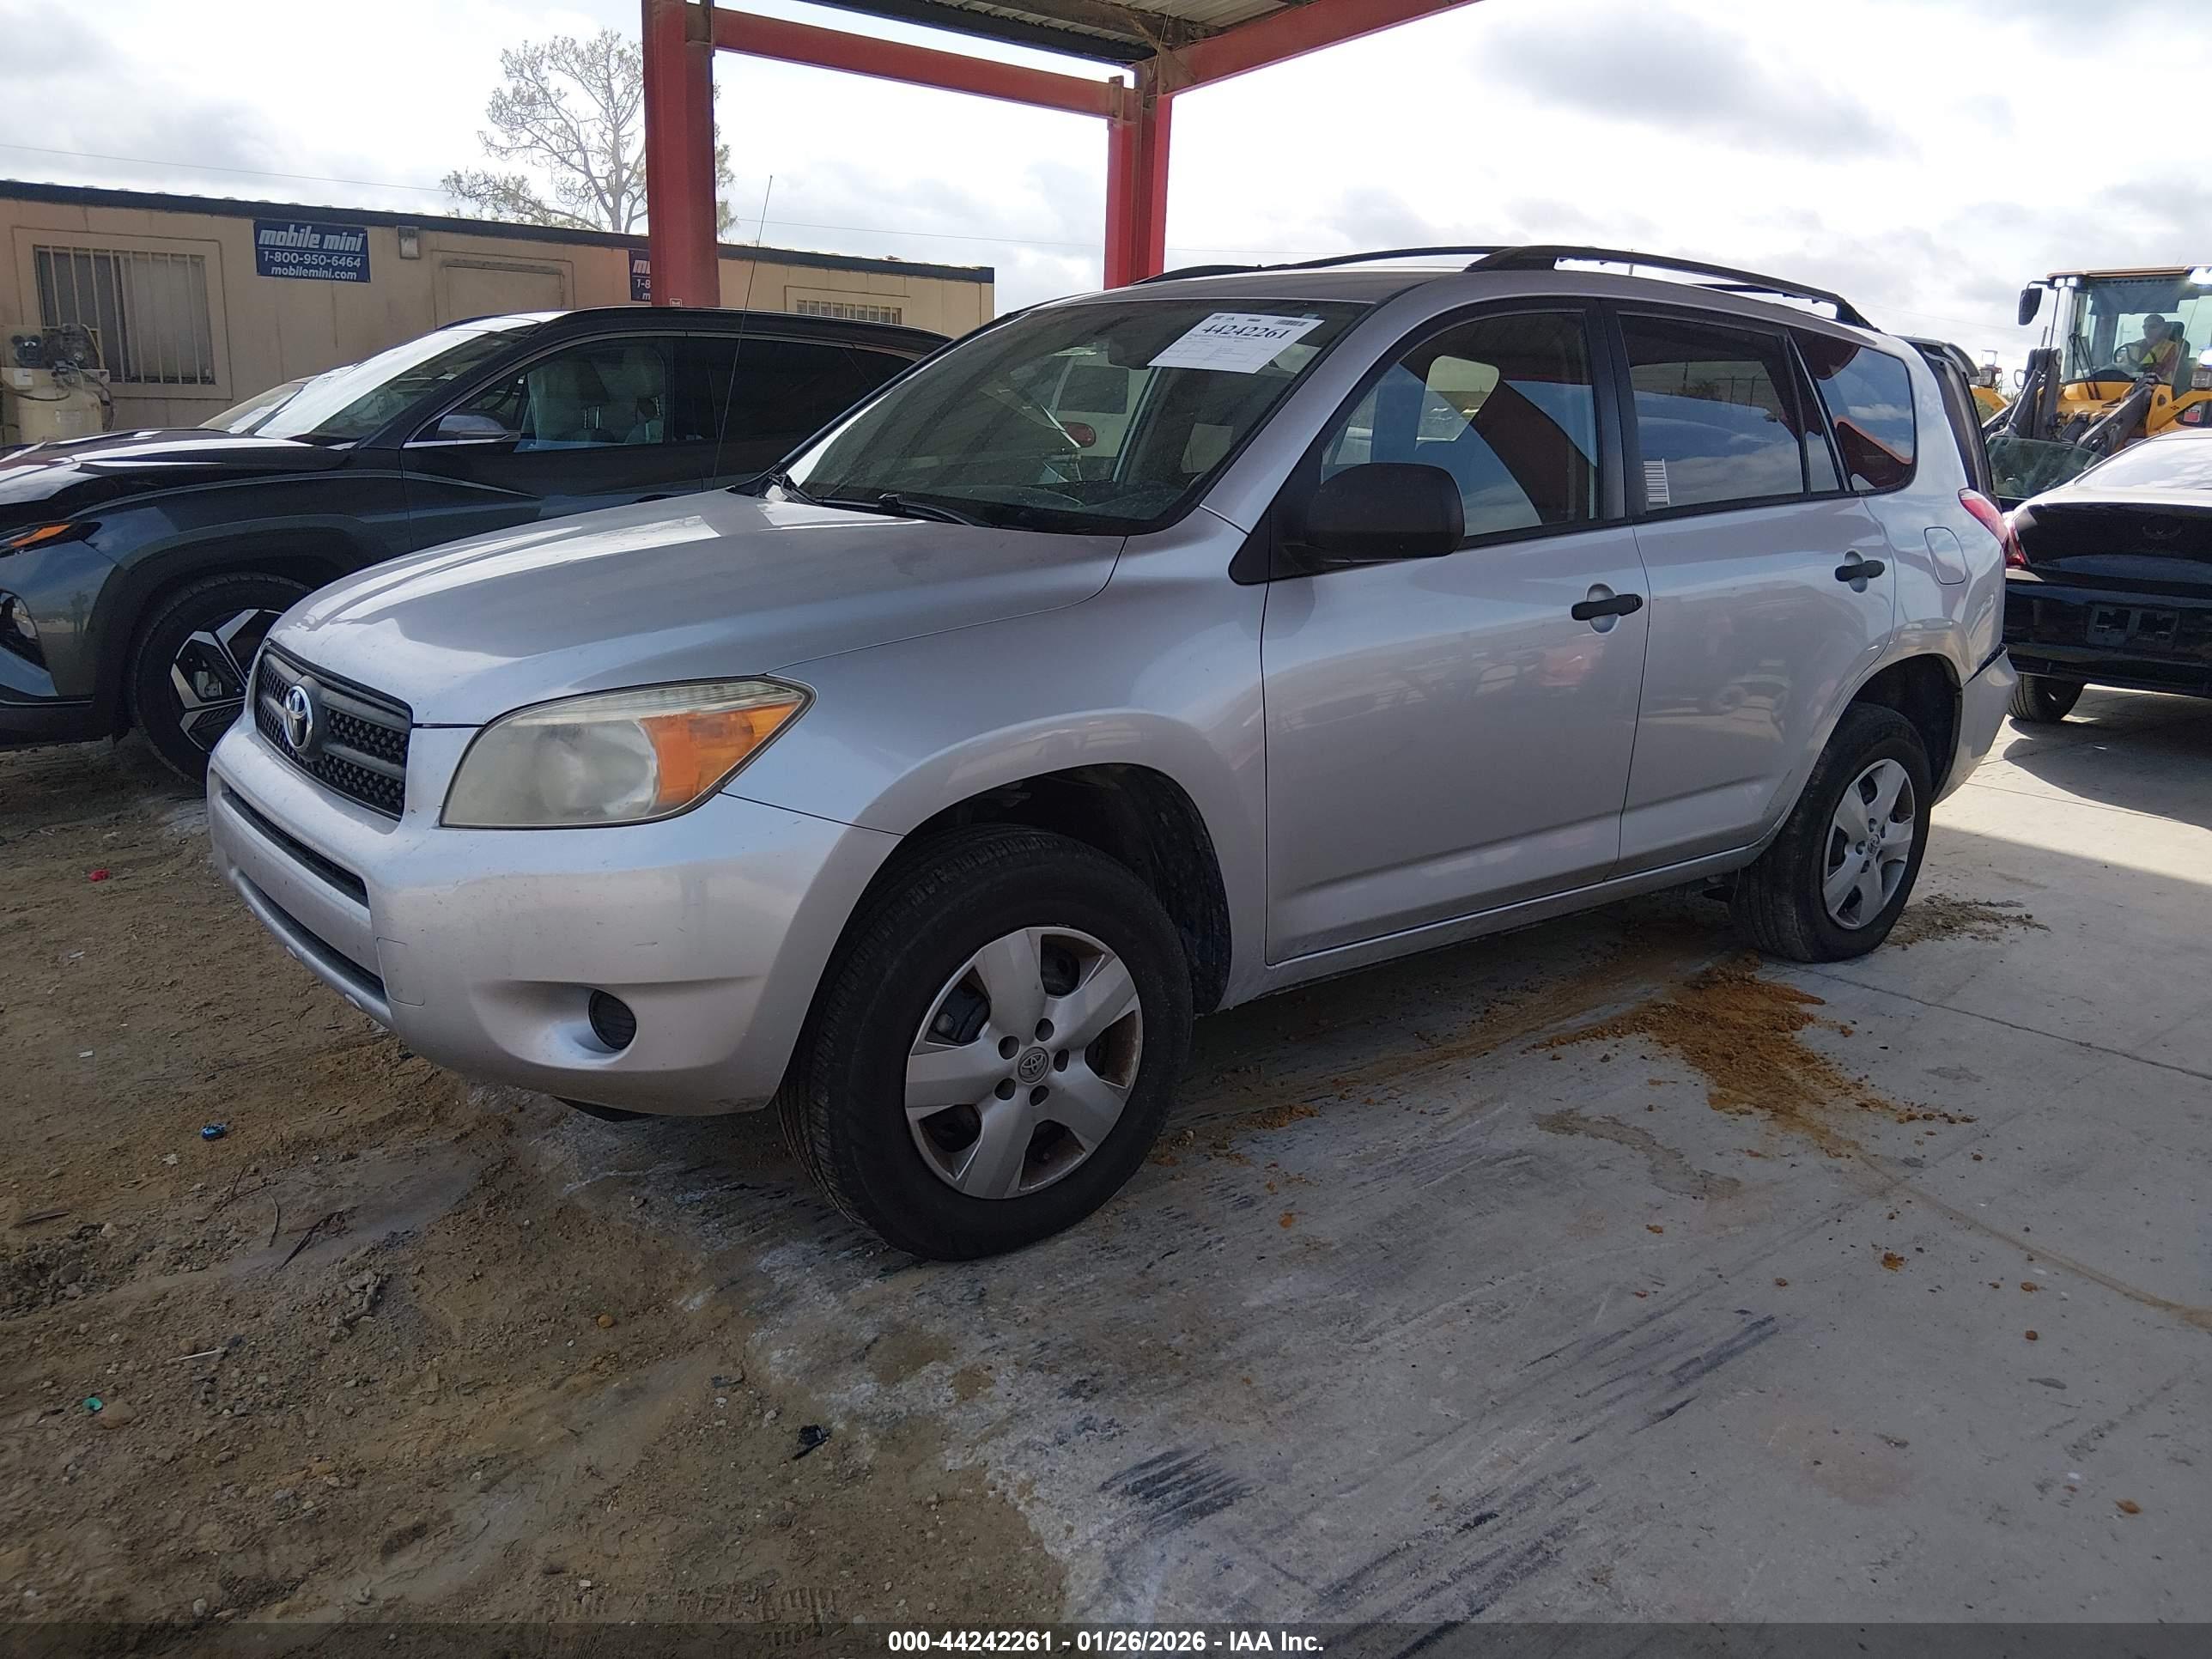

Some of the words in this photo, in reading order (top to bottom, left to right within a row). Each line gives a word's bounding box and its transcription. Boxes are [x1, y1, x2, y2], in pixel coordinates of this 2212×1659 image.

[258, 224, 321, 248] mobile
[322, 232, 366, 252] mini
[264, 251, 362, 268] 1-800-950-6464
[270, 265, 357, 280] mobilemini.com
[1202, 324, 1292, 339] 44242261
